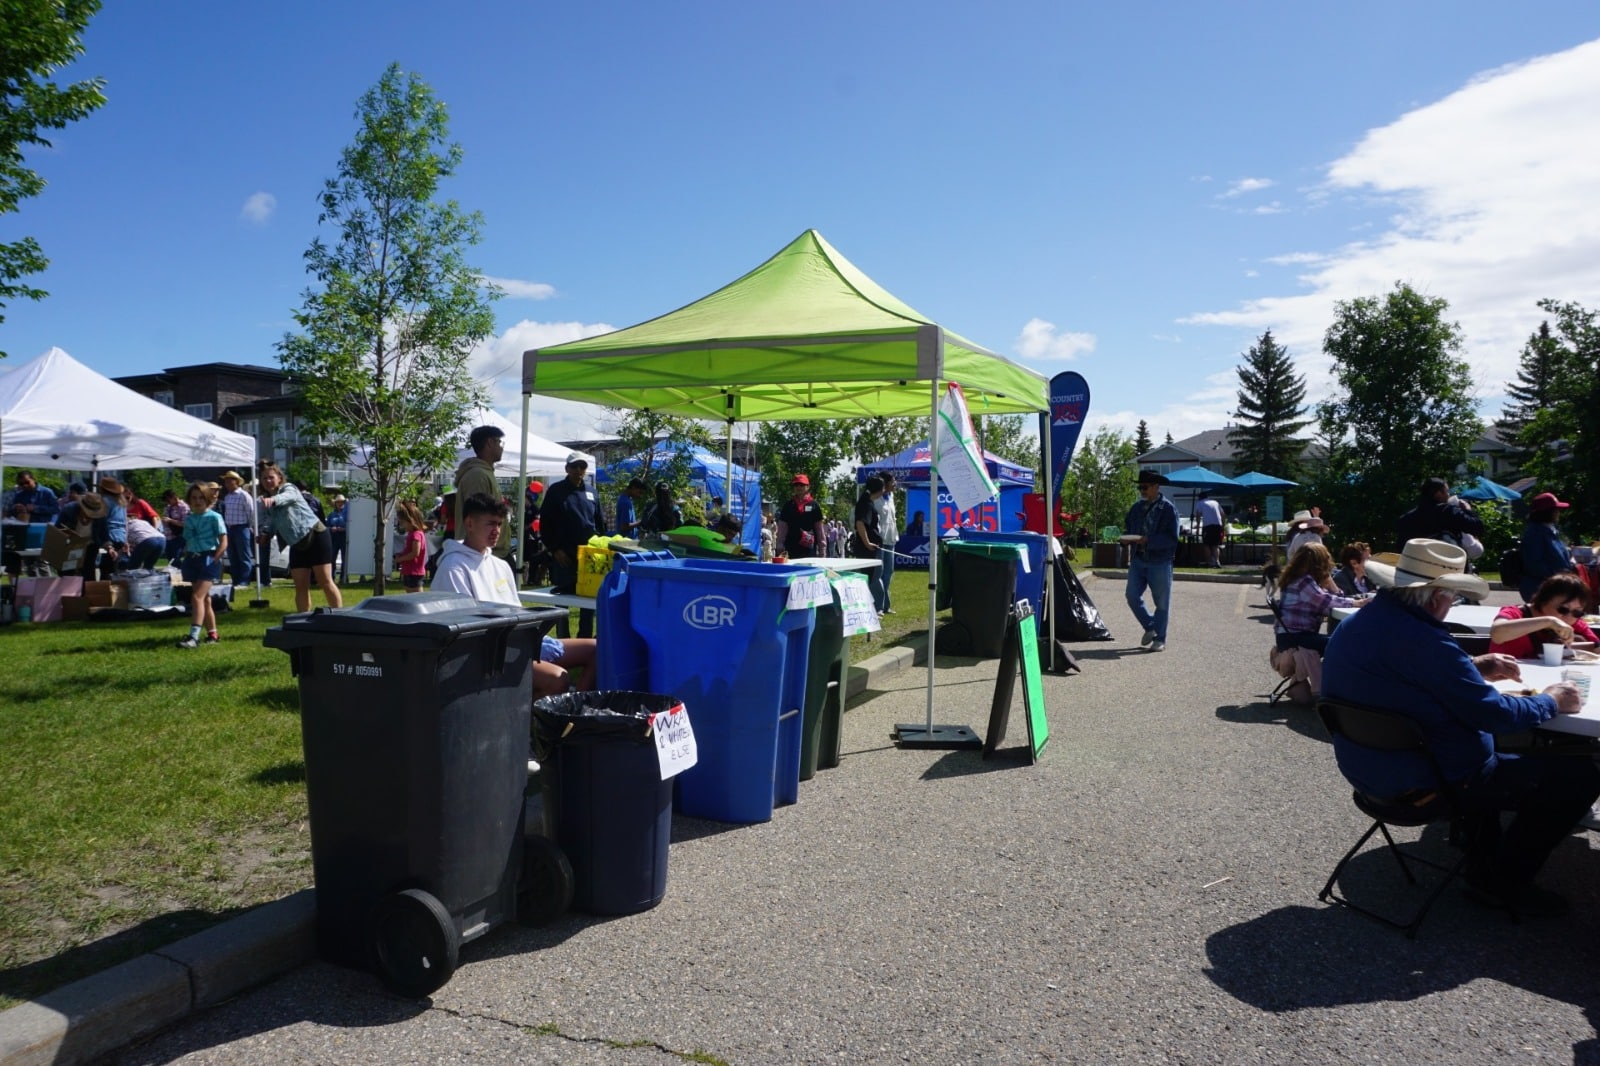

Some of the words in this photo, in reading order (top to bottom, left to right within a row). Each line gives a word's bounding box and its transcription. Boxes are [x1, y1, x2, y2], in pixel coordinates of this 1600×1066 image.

[941, 505, 998, 532] 105
[692, 606, 736, 627] LBR
[333, 663, 345, 674] 517
